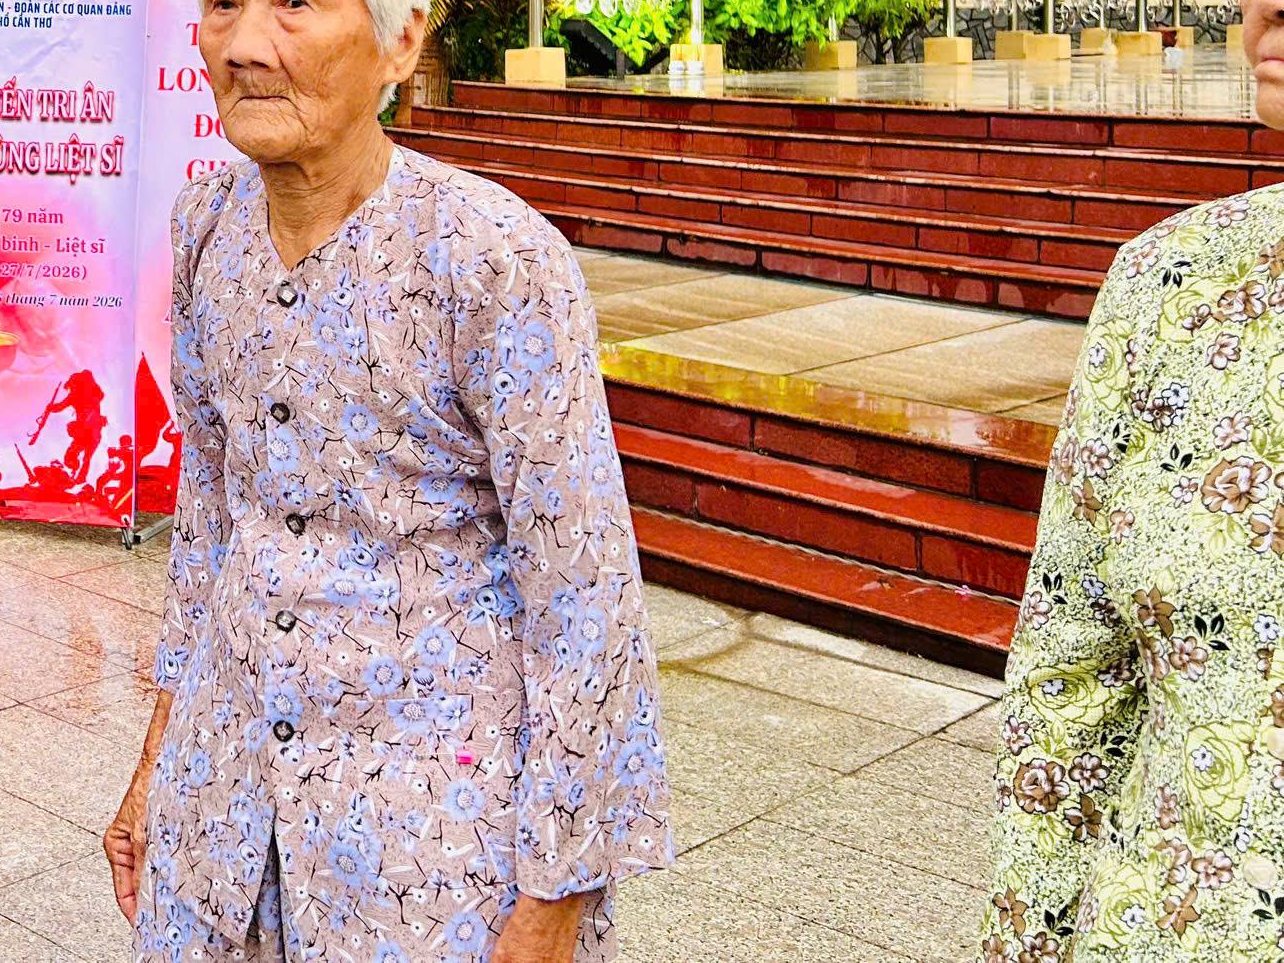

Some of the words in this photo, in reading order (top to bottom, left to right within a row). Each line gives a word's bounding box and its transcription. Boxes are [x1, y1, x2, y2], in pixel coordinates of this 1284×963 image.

[14, 0, 40, 13] ĐOÀN
[43, 0, 60, 14] CÁC
[63, 3, 75, 14] CƠ
[77, 3, 103, 16] QUAN
[34, 16, 53, 28] THƠ
[157, 67, 213, 92] LON
[37, 88, 77, 122] TRI
[80, 80, 116, 122] ÂN
[43, 133, 96, 184] LIỆT
[100, 135, 125, 176] SĨ
[2, 208, 23, 223] 79
[27, 208, 64, 224] năm
[55, 237, 87, 258] Liệt
[90, 238, 106, 254] sĩ
[49, 294, 57, 306] 7
[92, 296, 123, 308] 2026
